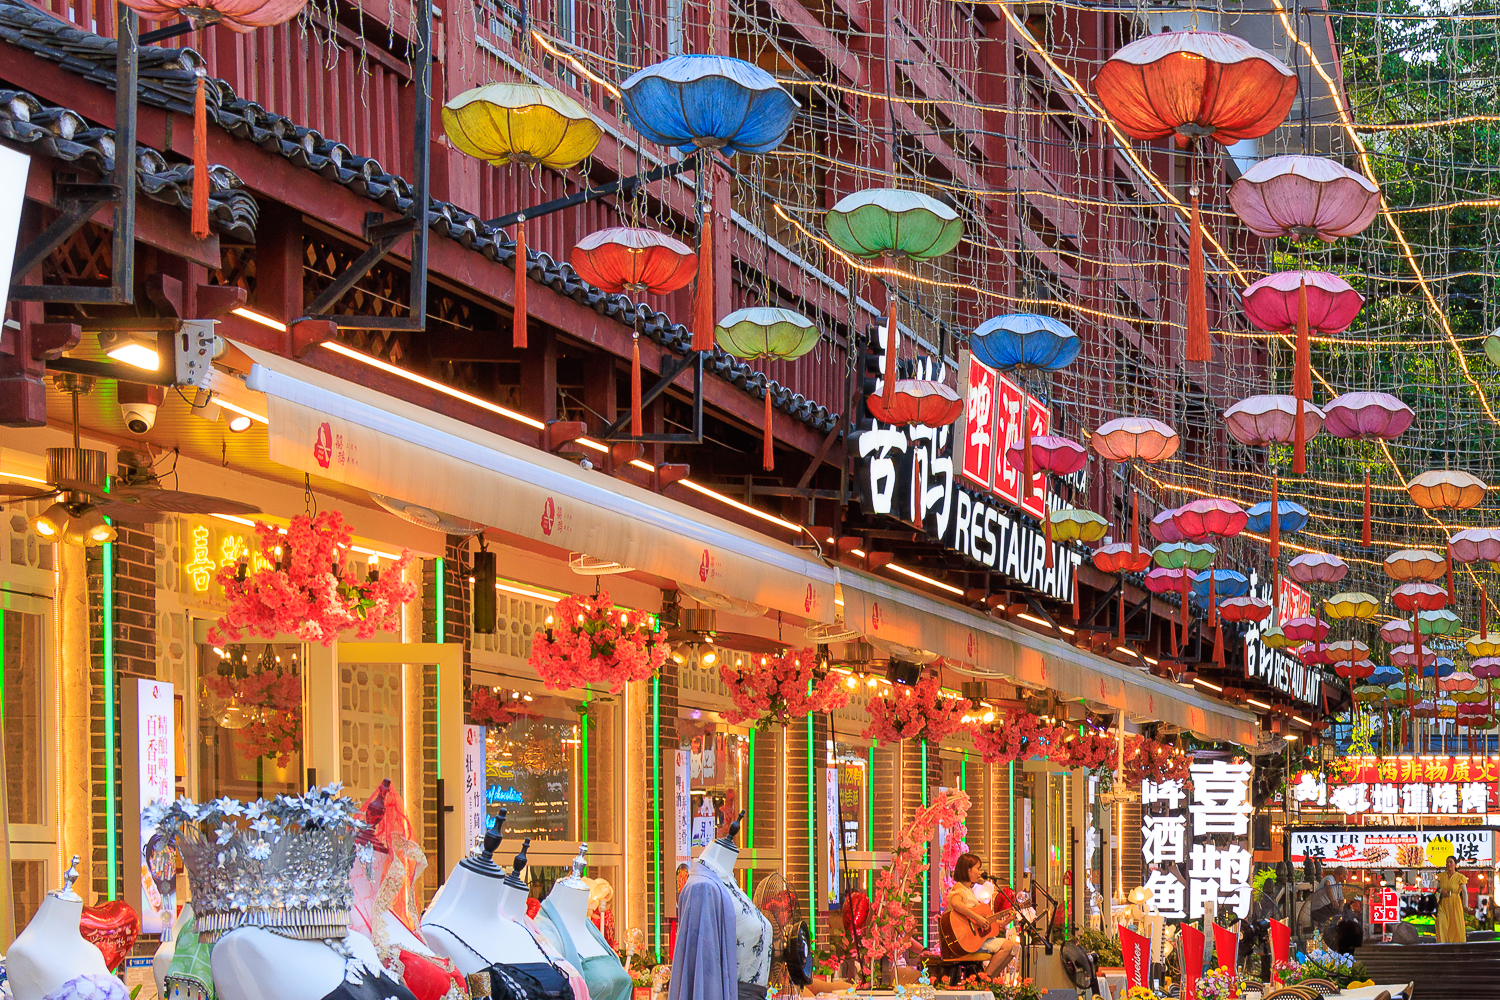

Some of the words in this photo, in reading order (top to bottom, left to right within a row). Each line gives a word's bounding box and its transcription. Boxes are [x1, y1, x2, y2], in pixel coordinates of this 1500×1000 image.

[955, 490, 1081, 604] RESTAURANT
[146, 714, 158, 786] 百香果
[1188, 760, 1254, 920] 喜鹊
[1296, 834, 1359, 844] MASTER
[1422, 833, 1489, 844] KAOROU
[1132, 942, 1142, 988] dweiser
